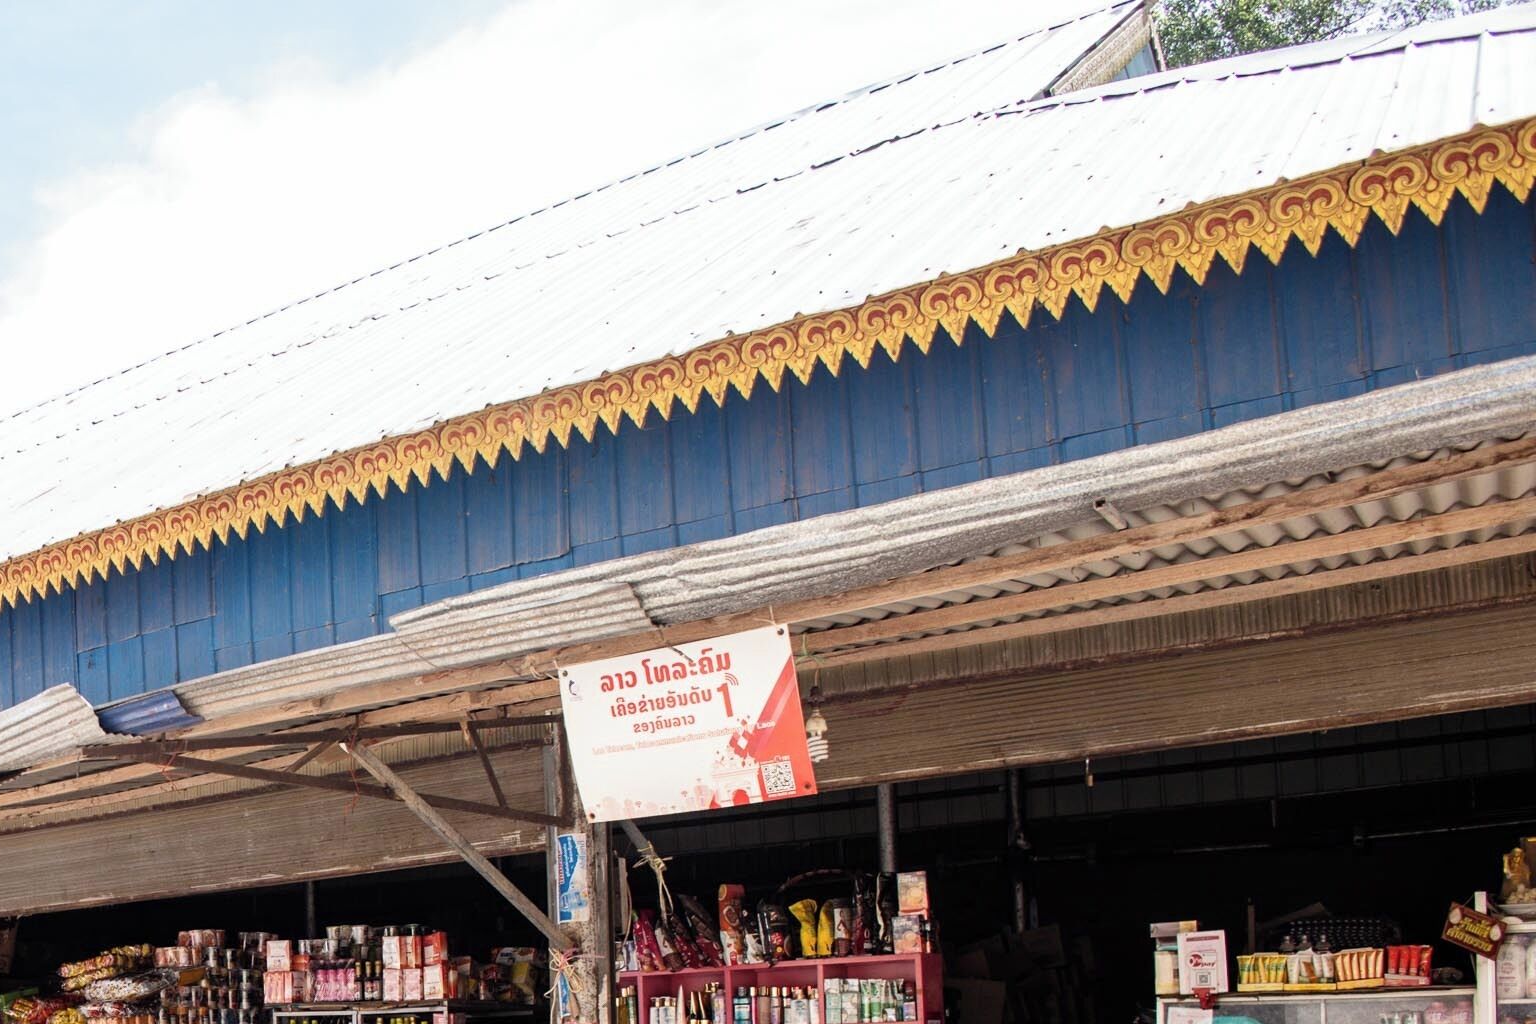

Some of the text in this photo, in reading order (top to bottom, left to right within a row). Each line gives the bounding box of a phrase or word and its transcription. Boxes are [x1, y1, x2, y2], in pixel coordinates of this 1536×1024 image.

[599, 647, 732, 693] ລາວ ໂທລະຄົມ
[716, 682, 734, 718] 1
[633, 714, 696, 734] ຂອງຄົນລາວ
